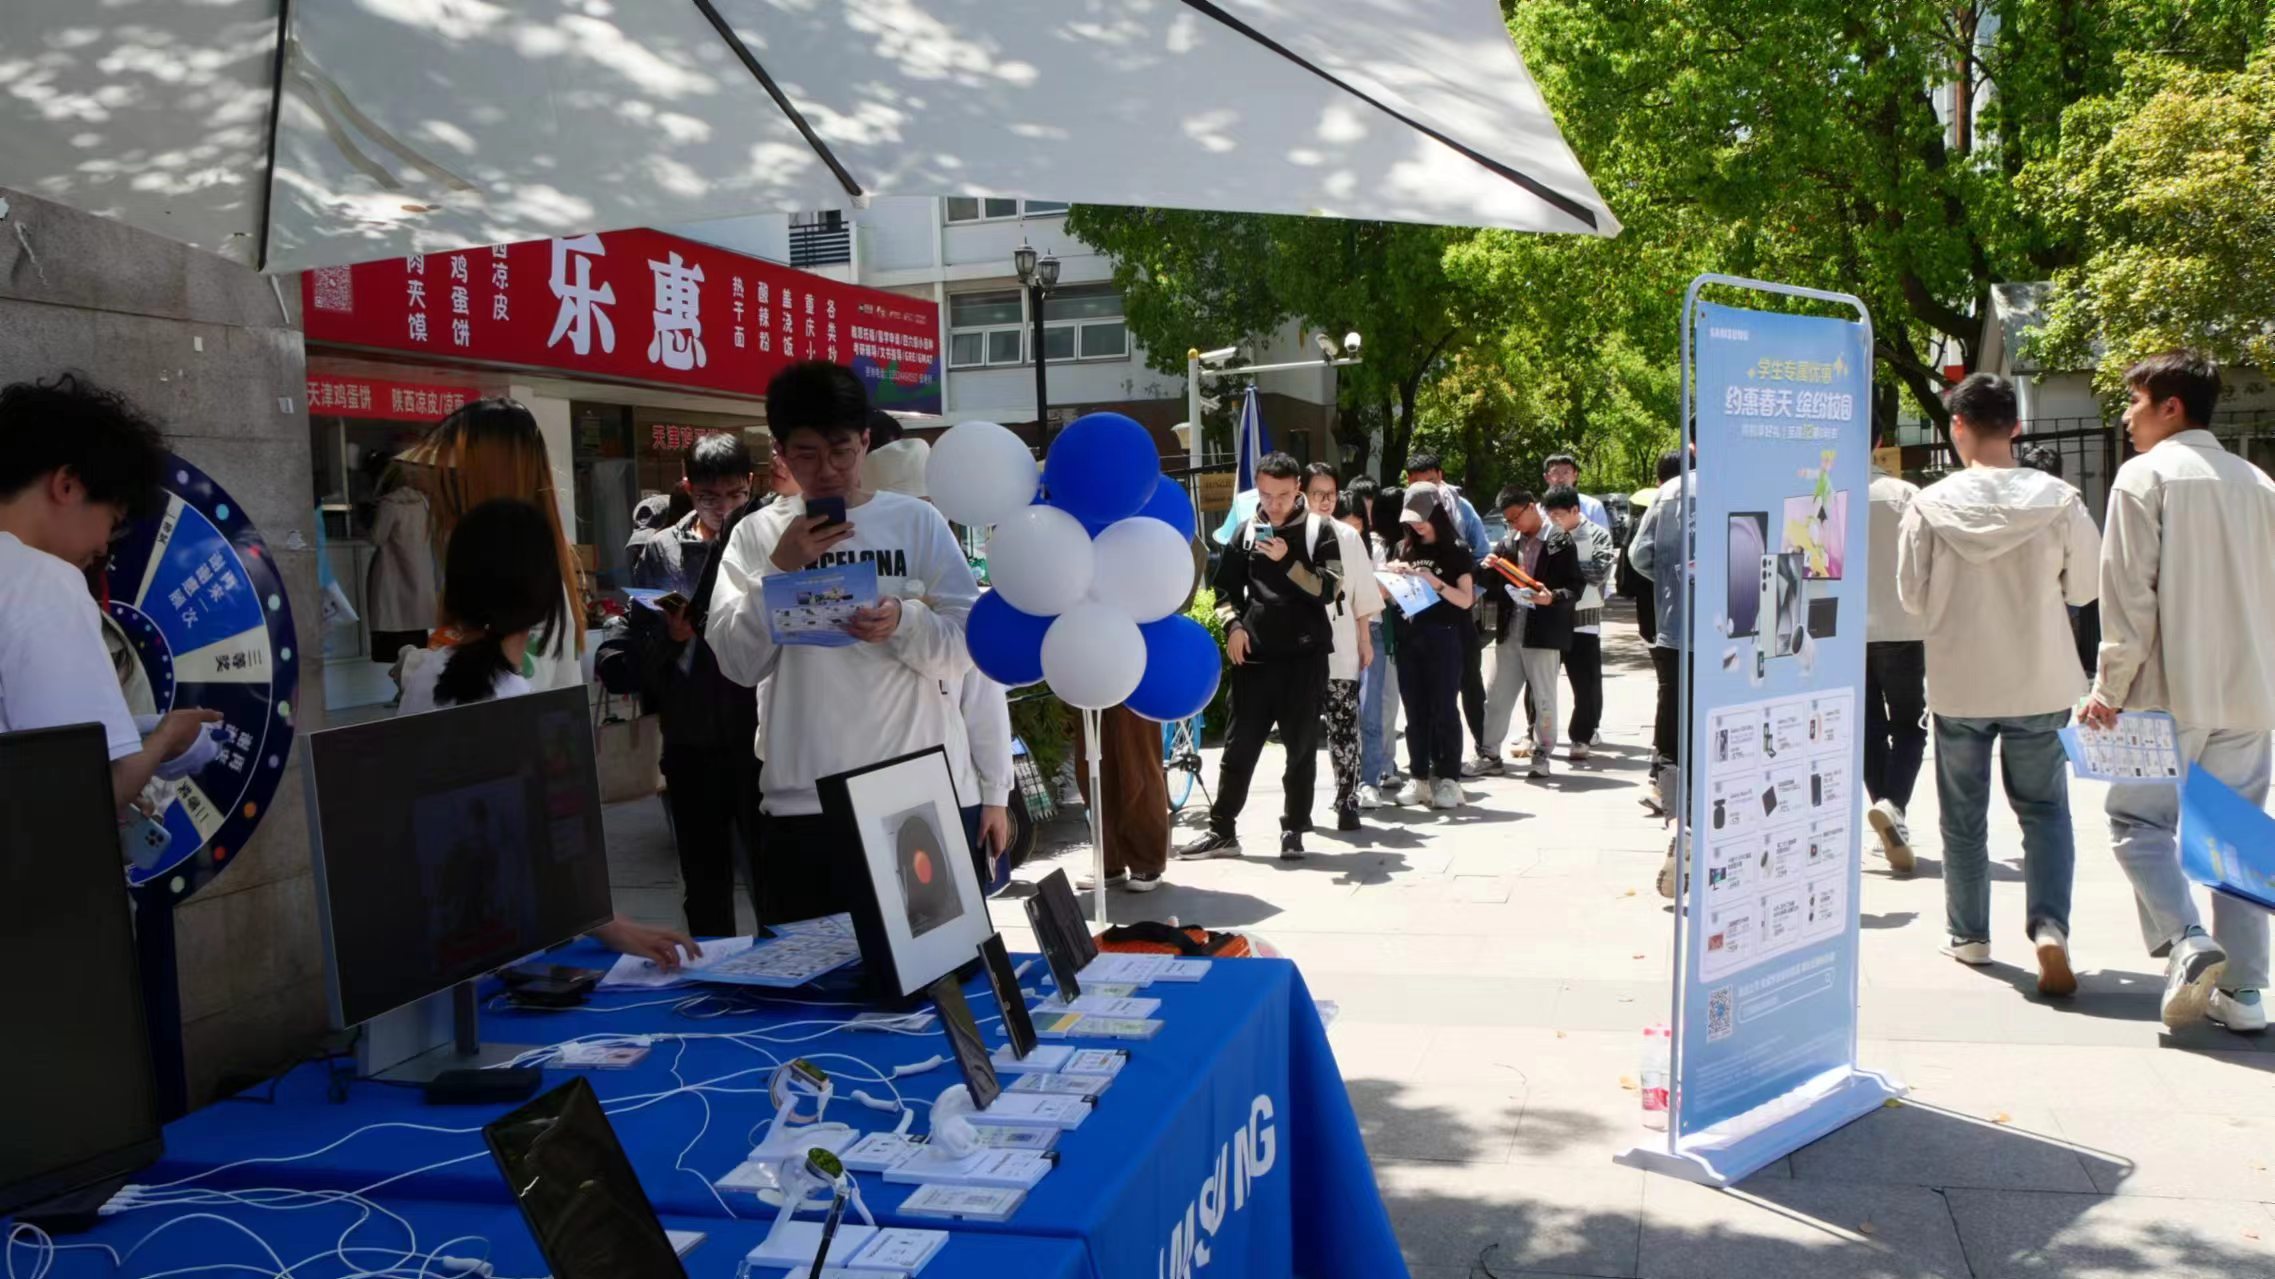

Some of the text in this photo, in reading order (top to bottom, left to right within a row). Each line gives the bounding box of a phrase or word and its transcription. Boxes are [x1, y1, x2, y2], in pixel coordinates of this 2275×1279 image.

[407, 254, 428, 342] 肉夹馍
[451, 254, 470, 347] 鸡蛋饼
[547, 232, 707, 370] 乐惠
[733, 275, 745, 348] 热干面
[758, 281, 770, 352] 酸辣粉
[782, 288, 794, 357] 盖浇饭
[307, 382, 372, 410] 天津鸡蛋饼
[1725, 386, 1853, 421] 约惠春天 缤纷校园
[652, 424, 720, 449] 天津鸡
[215, 647, 262, 673] 三等奖
